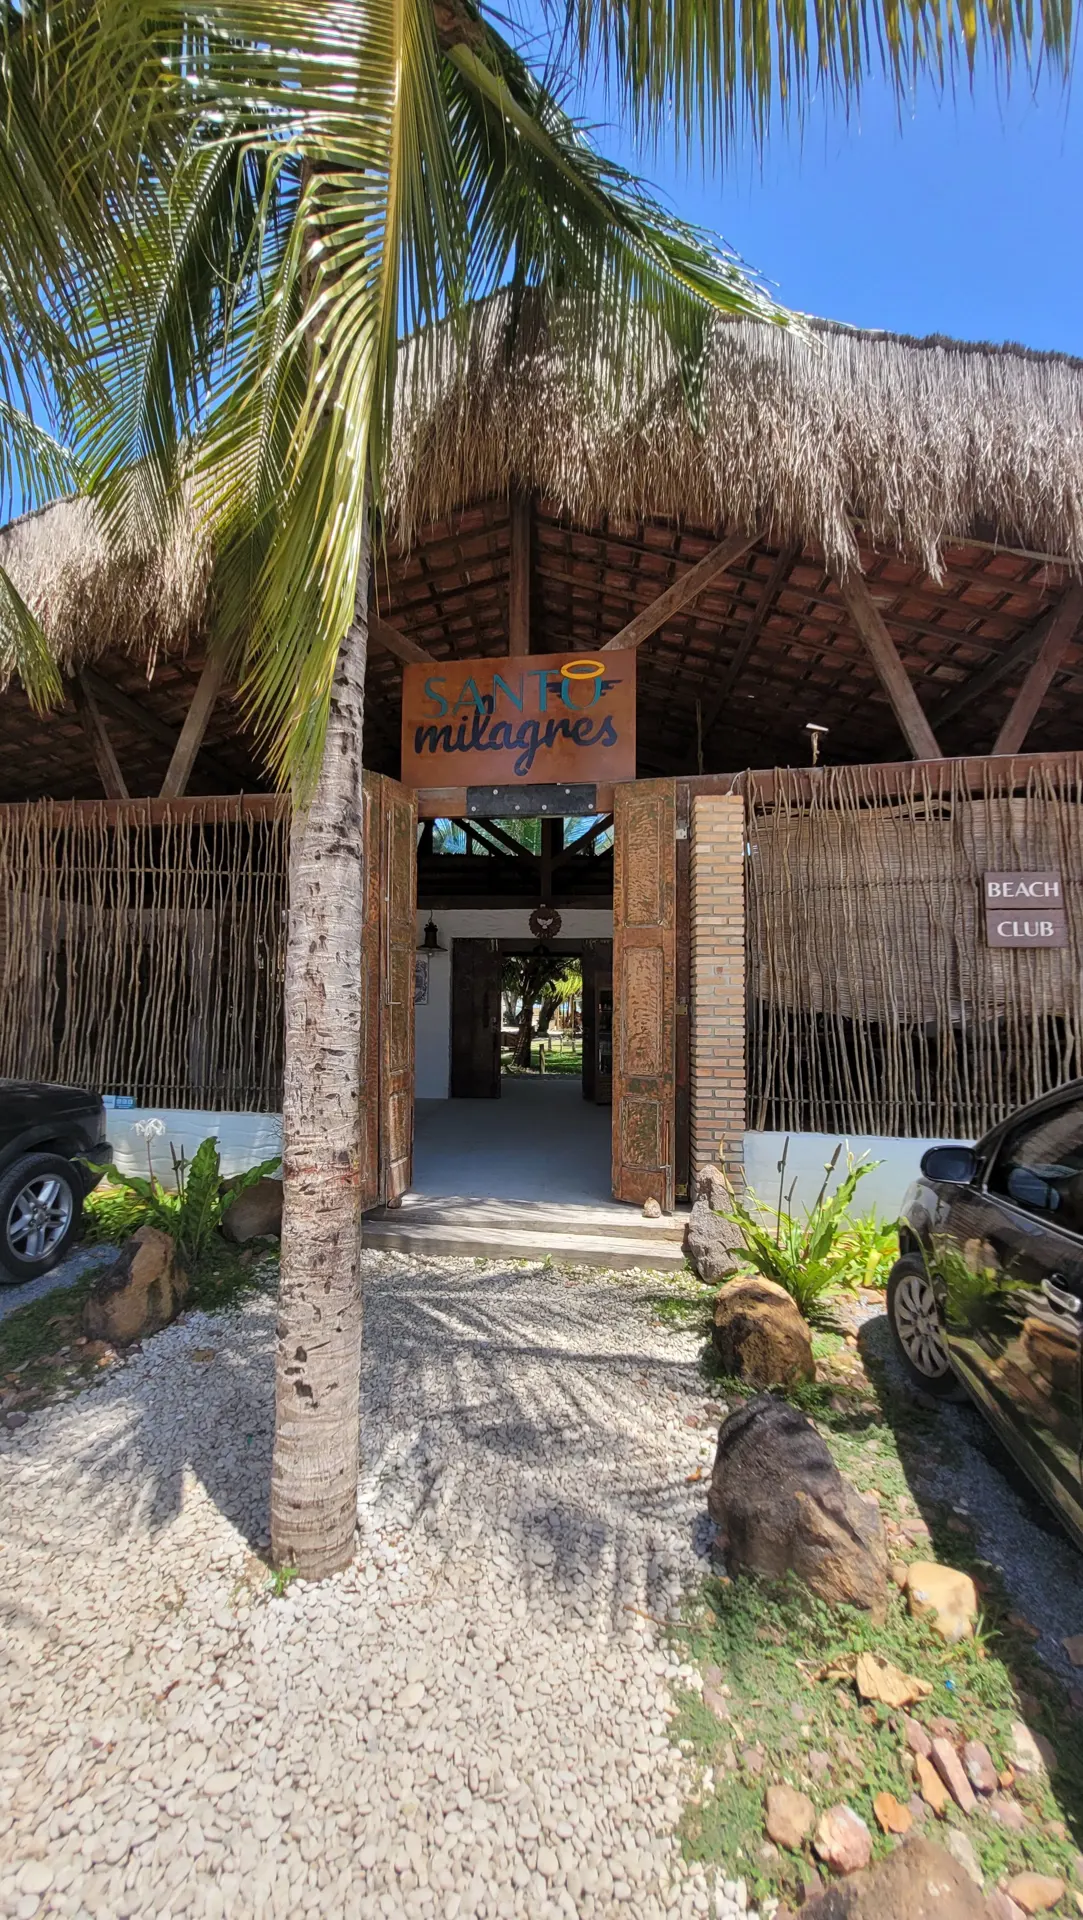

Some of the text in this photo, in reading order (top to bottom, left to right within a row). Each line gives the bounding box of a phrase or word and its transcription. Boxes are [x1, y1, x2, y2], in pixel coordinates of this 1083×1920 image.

[423, 667, 602, 719] SANTO
[414, 694, 618, 776] milagres
[987, 881, 1059, 898] BEACH
[997, 921, 1054, 937] CLUB
